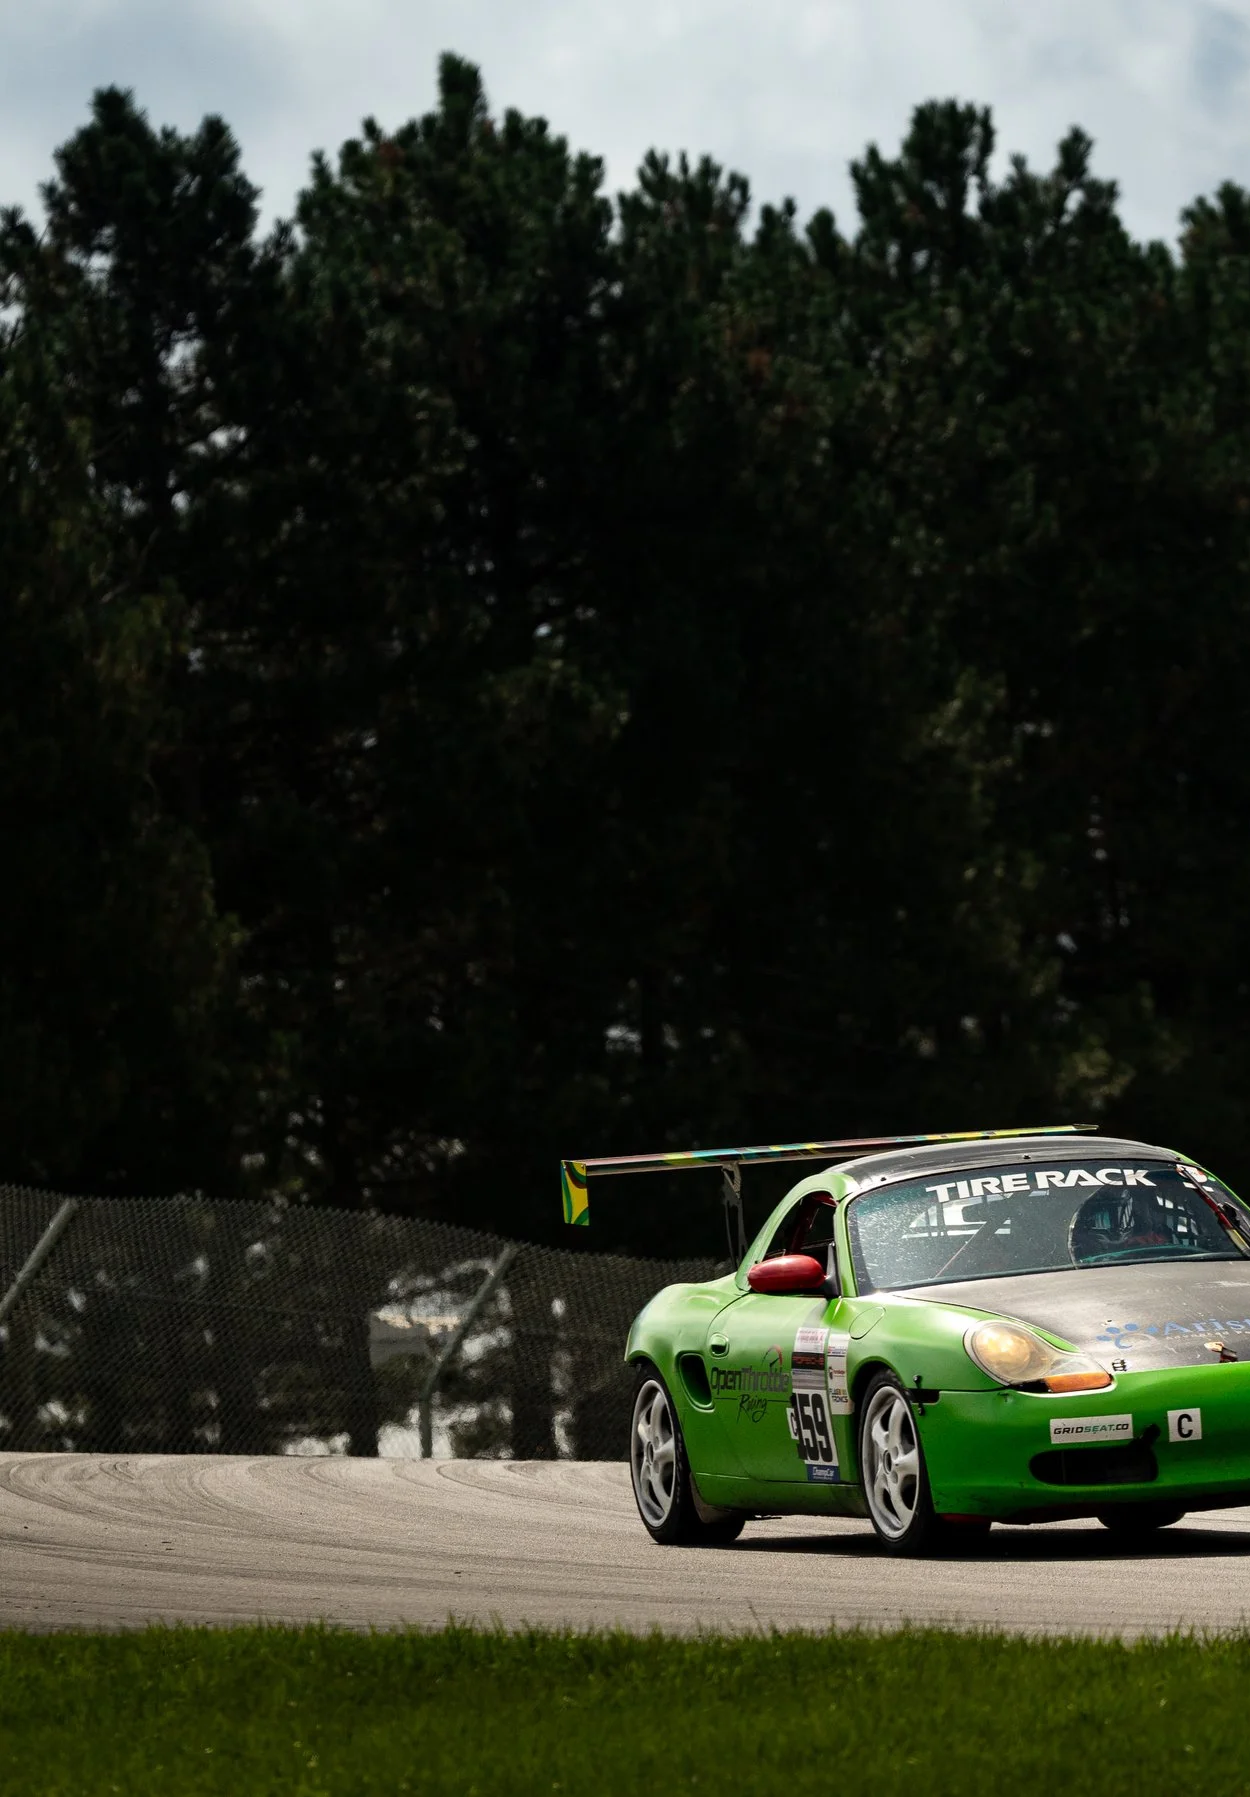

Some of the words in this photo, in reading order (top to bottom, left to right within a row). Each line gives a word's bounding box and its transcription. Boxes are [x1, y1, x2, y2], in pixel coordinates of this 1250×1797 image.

[925, 1172, 1030, 1203] TIRE
[1034, 1168, 1157, 1188] RACK
[790, 1392, 833, 1463] 159
[1053, 1423, 1130, 1435] GRIDSEAT.CO
[1177, 1413, 1193, 1439] C
